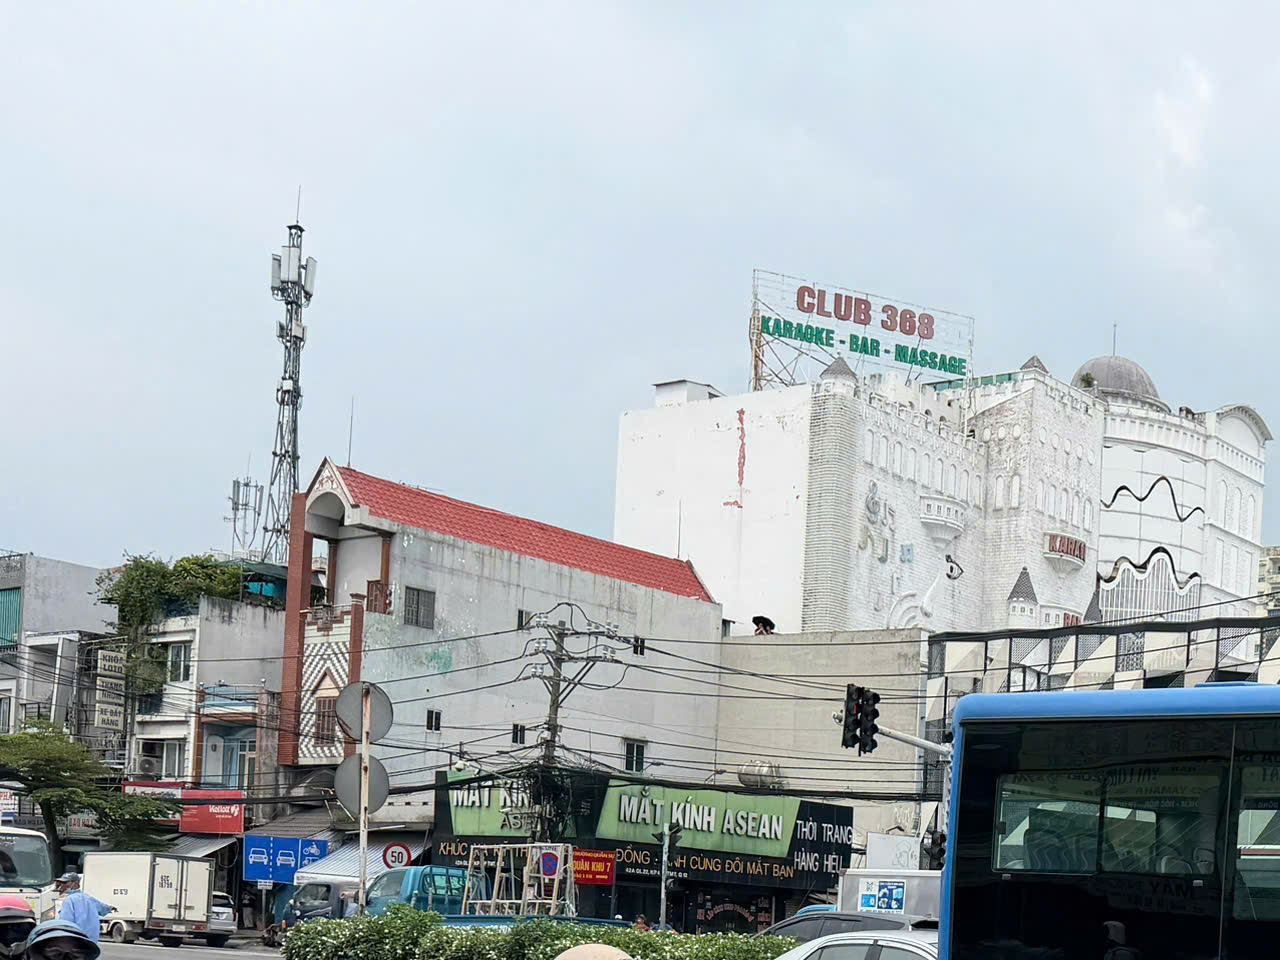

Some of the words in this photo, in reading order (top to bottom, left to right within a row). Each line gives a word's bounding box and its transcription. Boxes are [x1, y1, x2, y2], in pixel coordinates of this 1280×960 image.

[796, 285, 872, 326] CLUB
[881, 304, 935, 340] 368
[761, 315, 835, 348] KARAOKE
[850, 333, 881, 358] BAR
[895, 344, 967, 376] MASSAGE
[619, 785, 664, 826] MẮT
[671, 796, 716, 833] KÍNH
[722, 808, 783, 840] ASEAN
[438, 838, 468, 856] KHÚC
[822, 823, 853, 845] TRANG
[390, 851, 404, 864] 50
[592, 861, 605, 872] KHU
[606, 862, 611, 873] 7
[690, 854, 722, 871] CÙNG
[725, 857, 744, 873] ĐÔI
[747, 857, 770, 876] MẮT
[773, 865, 794, 880] BẠN
[794, 848, 820, 872] HÀNG
[823, 851, 843, 878] HIỆU
